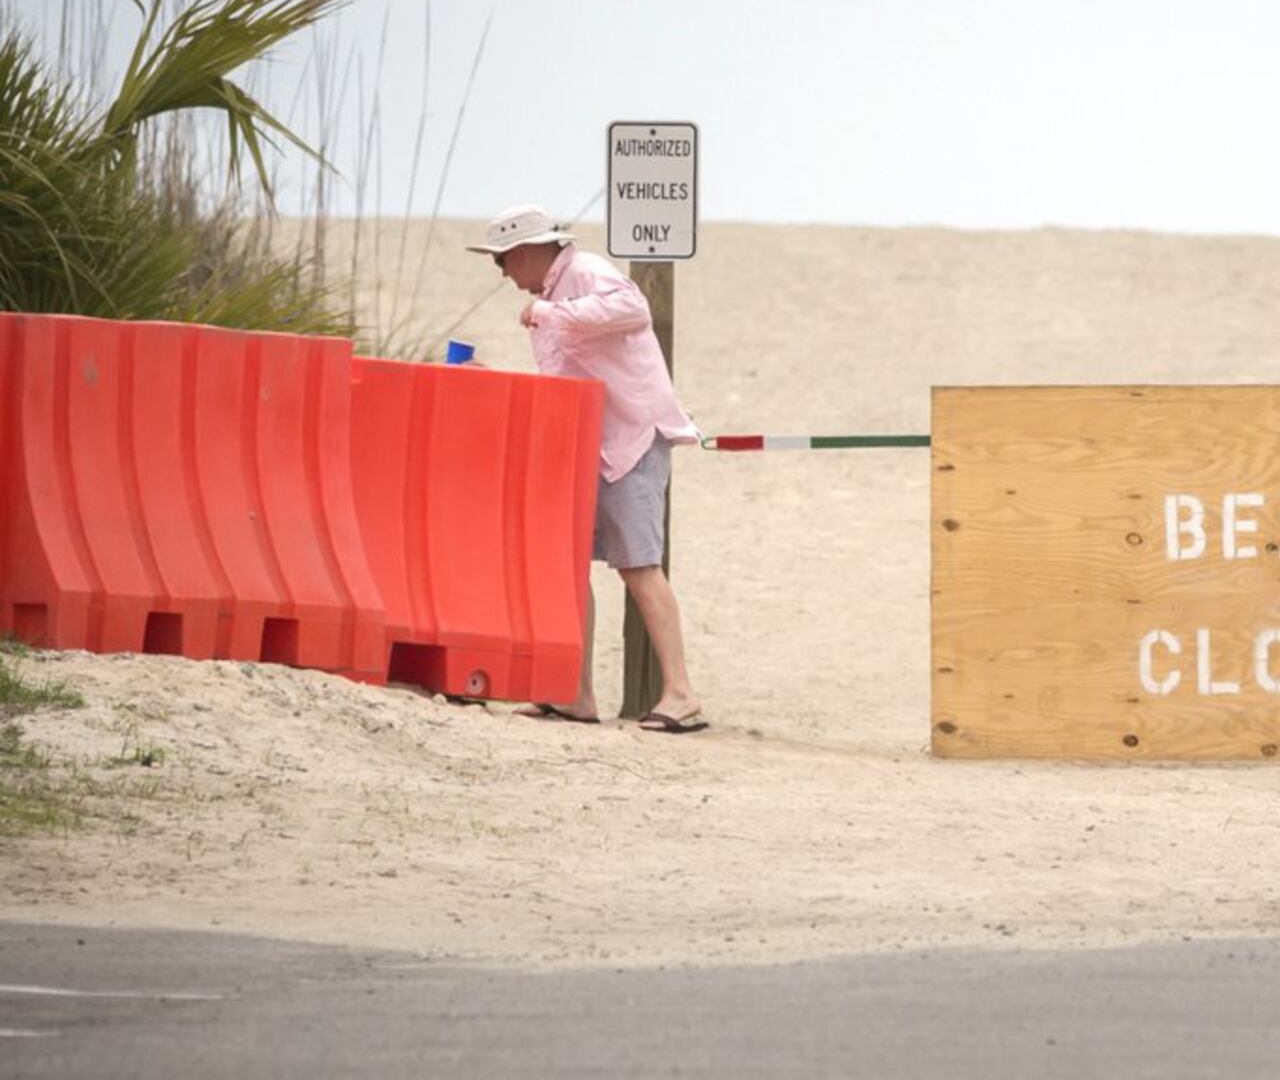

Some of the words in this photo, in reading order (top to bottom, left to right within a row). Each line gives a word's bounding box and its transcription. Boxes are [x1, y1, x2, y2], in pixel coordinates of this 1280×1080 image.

[615, 139, 691, 157] AUTHORIZED
[616, 182, 689, 201] VEHICLES
[632, 225, 671, 242] ONLY
